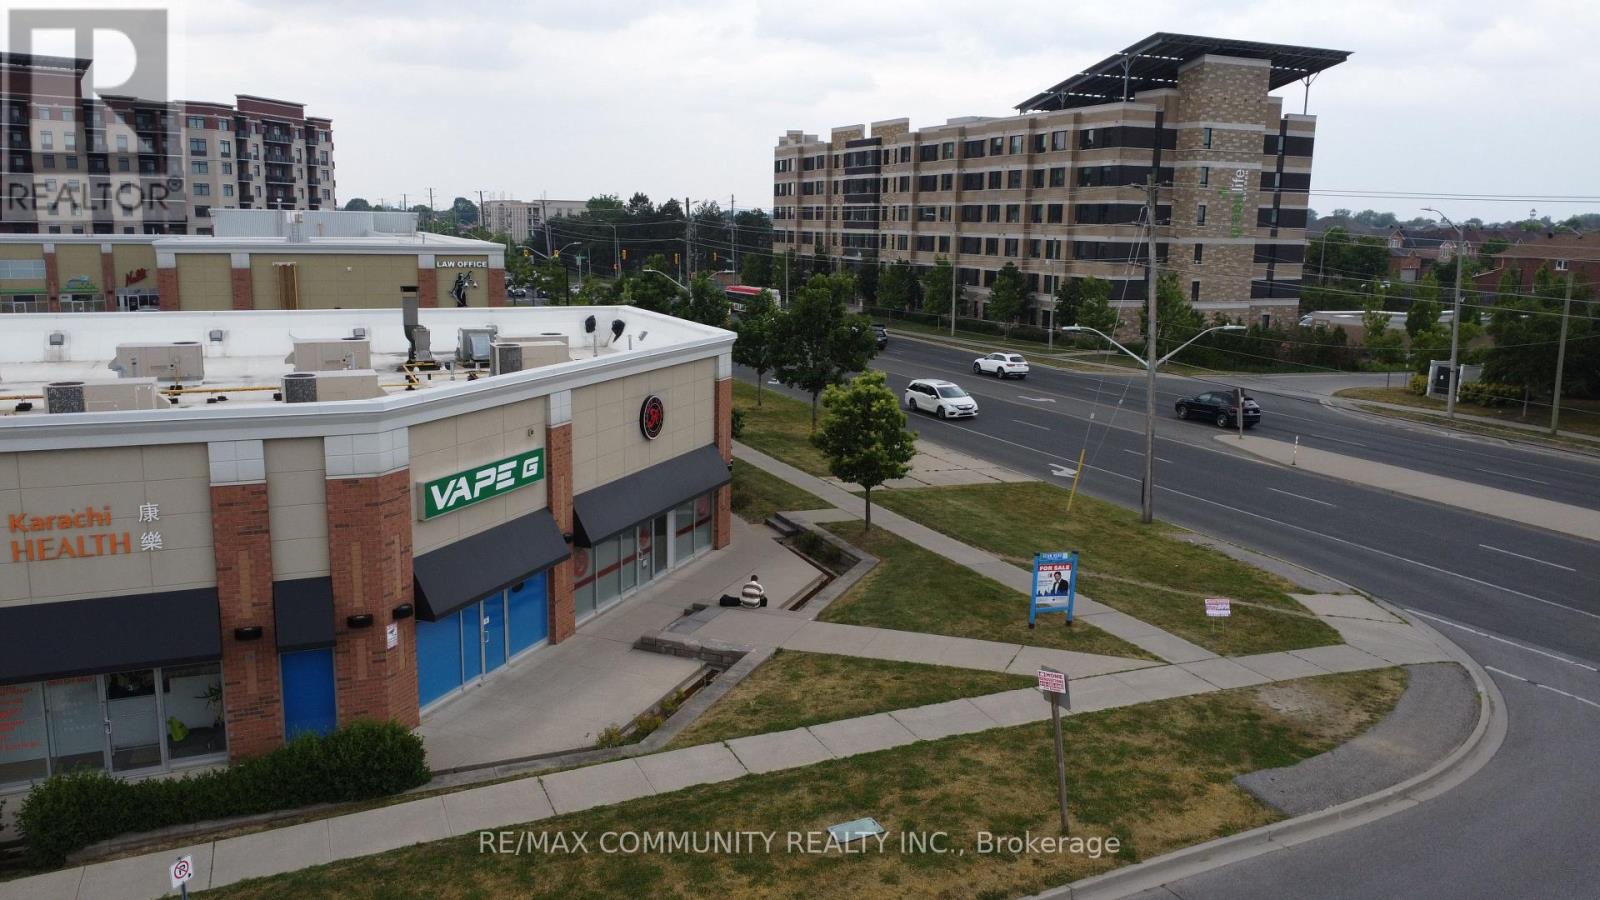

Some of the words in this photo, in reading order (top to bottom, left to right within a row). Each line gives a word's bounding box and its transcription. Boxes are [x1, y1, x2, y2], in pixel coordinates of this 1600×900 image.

[436, 260, 455, 268] LAW
[457, 260, 488, 268] OFFICE
[430, 459, 518, 511] VAPE
[521, 456, 540, 479] G
[8, 504, 112, 533] Karachi
[11, 531, 132, 562] HEALTH
